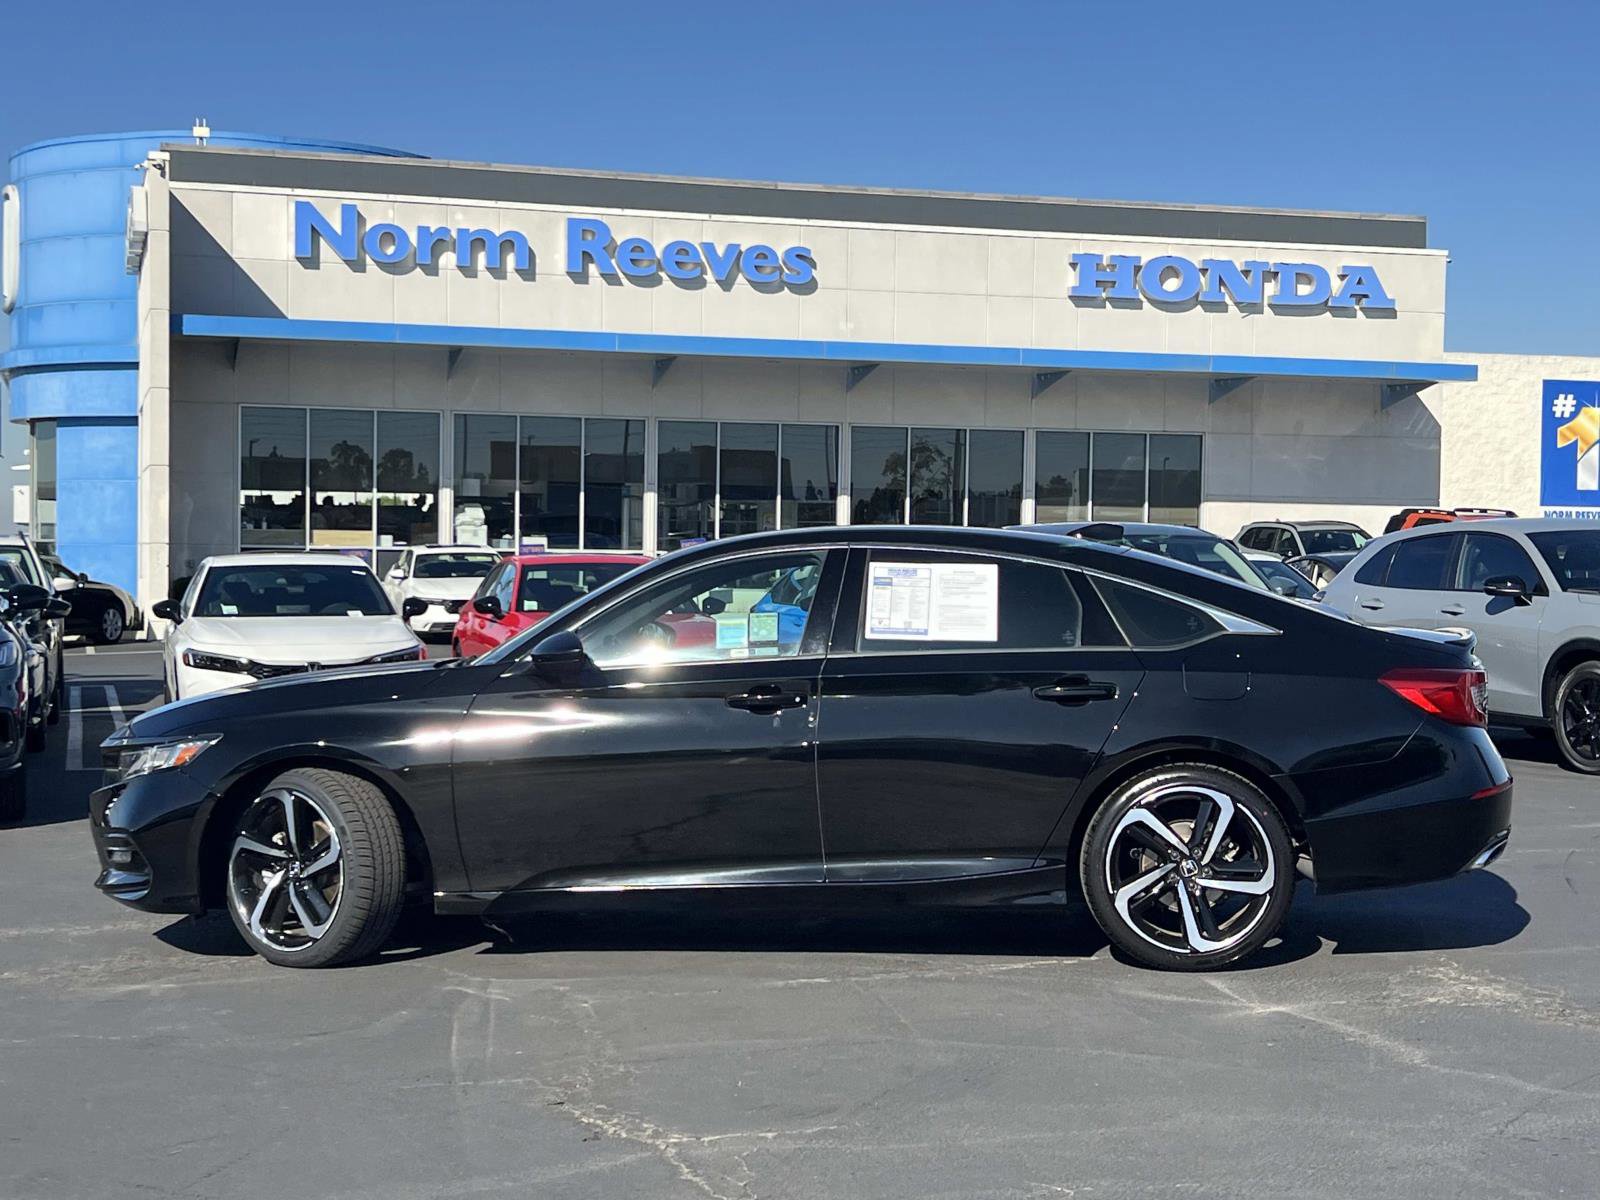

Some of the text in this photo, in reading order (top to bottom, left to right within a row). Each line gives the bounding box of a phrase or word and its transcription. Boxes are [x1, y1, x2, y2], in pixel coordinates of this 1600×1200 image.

[294, 200, 815, 287] Norm Reeves
[1068, 252, 1397, 311] HONDA
